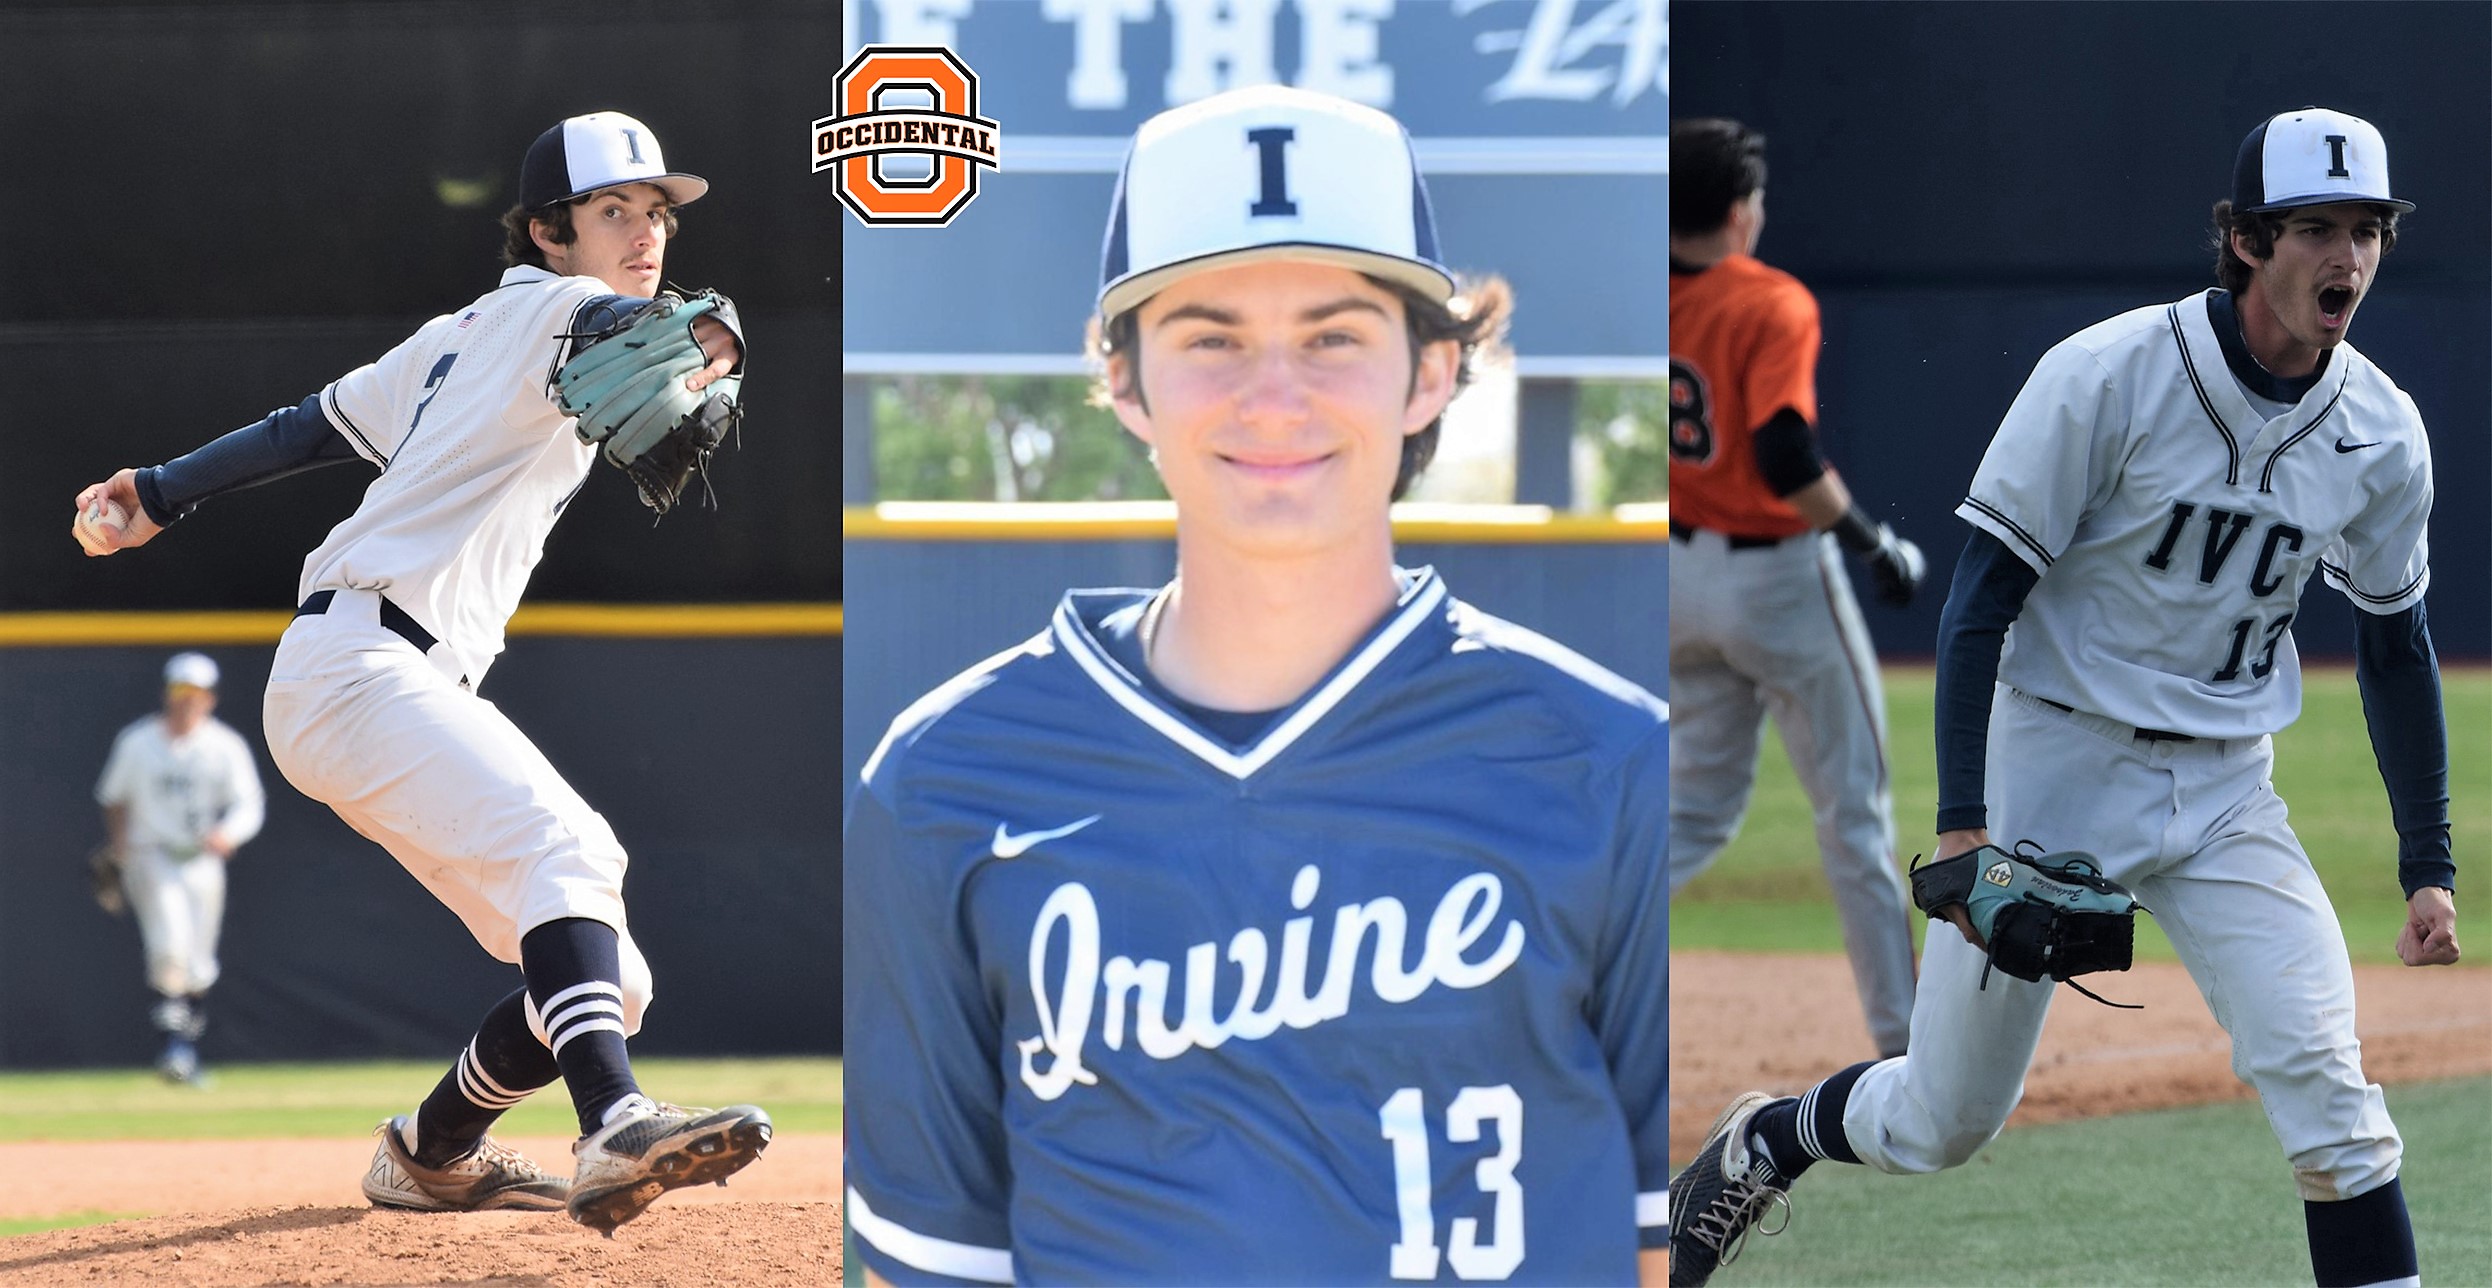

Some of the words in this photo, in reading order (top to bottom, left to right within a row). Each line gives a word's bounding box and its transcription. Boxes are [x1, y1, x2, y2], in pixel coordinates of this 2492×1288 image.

[1041, 0, 1397, 110] THE
[619, 127, 647, 165] I
[1246, 127, 1298, 217] I
[2323, 134, 2351, 180] I
[2143, 501, 2305, 599] IVC
[2211, 611, 2294, 682] 13
[1018, 864, 1525, 1101] Irvine
[1379, 1084, 1525, 1281] 13
